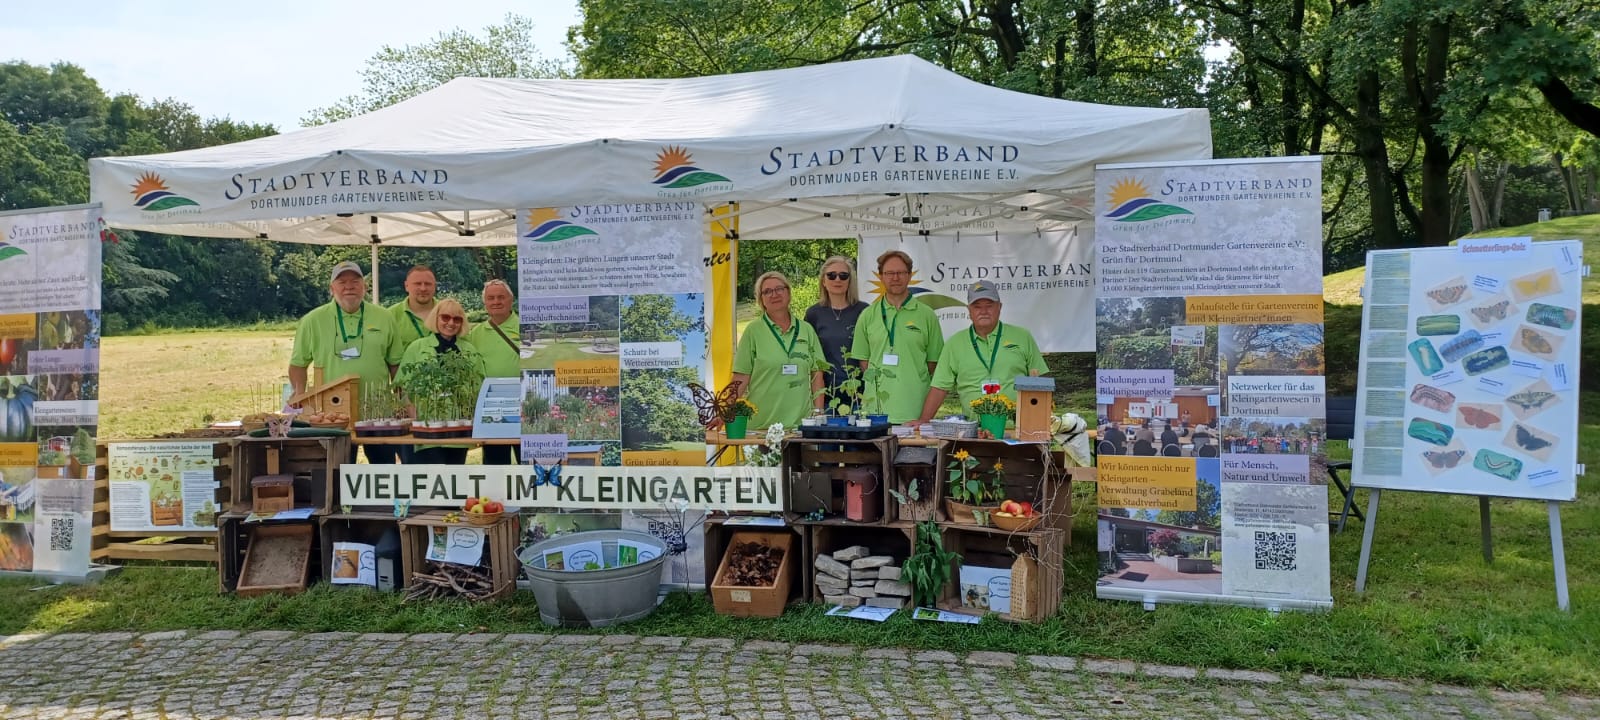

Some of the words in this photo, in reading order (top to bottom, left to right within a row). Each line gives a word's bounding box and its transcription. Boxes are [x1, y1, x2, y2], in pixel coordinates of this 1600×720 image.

[761, 145, 1019, 175] STADTVERBAND
[790, 171, 879, 186] DORTMUNDER
[884, 169, 990, 182] GARTENVEREINE
[997, 168, 1019, 180] E.V.
[225, 168, 448, 200] STADTVERBAND
[1160, 177, 1312, 196] STADTVERBAND
[251, 194, 327, 209] DORTMUNDER
[332, 191, 425, 205] GARTENVEREINE
[428, 190, 448, 202] E.V.
[1178, 193, 1230, 203] DORTMUNDER
[1233, 192, 1296, 201] GARTENVEREINE
[1300, 191, 1312, 199] E.V.
[570, 201, 695, 218] STADTVERBAND
[585, 216, 628, 224] DORTMUNDER
[631, 214, 682, 223] GARTENVEREINE
[9, 222, 96, 240] STADTVERBAND
[1102, 245, 1117, 253] Der
[1119, 243, 1171, 253] Stadtverband
[1173, 242, 1225, 252] Dortmunder
[1227, 241, 1286, 250] Gartenvereine
[603, 255, 629, 264] Lungen
[656, 252, 675, 261] Stadt
[1102, 256, 1123, 264] Grün
[1125, 255, 1137, 264] für
[1139, 254, 1182, 264] Dortmund
[931, 262, 1092, 283] STADTVERBAN
[1207, 265, 1242, 273] Dortmund
[951, 280, 1013, 292] DORDER
[1016, 281, 1090, 290] GARTENVEREINE
[521, 302, 571, 312] Biotopverbund
[573, 302, 587, 310] und
[1189, 301, 1239, 311] Anlaufstelle
[1241, 301, 1253, 310] für
[1256, 301, 1319, 311] Gartenvereine
[521, 313, 586, 322] Frischluftschneisen
[1189, 313, 1206, 323] und
[623, 348, 647, 356] Schutz
[648, 348, 660, 356] bei
[624, 359, 680, 367] Wetterextremen
[557, 367, 582, 375] Unsere
[583, 366, 618, 374] natürliche
[1099, 375, 1147, 386] Schulungen
[1149, 375, 1166, 384] und
[1231, 382, 1281, 391] Netzwerker
[1284, 382, 1298, 391] für
[1299, 381, 1315, 391] das
[1099, 387, 1171, 397] Bildungsangebote
[1231, 394, 1310, 405] Kleingartenwesen
[1312, 395, 1321, 403] in
[1231, 406, 1279, 415] Dortmund
[523, 440, 550, 449] Hotspot
[551, 440, 564, 448] der
[523, 451, 566, 459] Biodiversität
[625, 458, 644, 466] Grün
[645, 457, 658, 466] für
[659, 458, 672, 466] alle
[1223, 460, 1239, 469] Für
[1241, 460, 1279, 470] Mensch,
[1100, 462, 1116, 471] Wir
[1118, 462, 1149, 471] können
[1151, 463, 1172, 473] nicht
[1100, 473, 1148, 485] Kleingarten
[1223, 472, 1249, 481] Natur
[1251, 472, 1269, 481] und
[1271, 473, 1306, 483] Umwelt
[345, 473, 486, 500] VIELFALT
[506, 474, 538, 501] IM
[556, 474, 777, 504] KLEINGARTEN
[1100, 486, 1147, 496] Verwaltung
[1149, 486, 1193, 497] Grabeland
[1100, 497, 1120, 505] beim
[1122, 498, 1178, 508] Stadtverband
